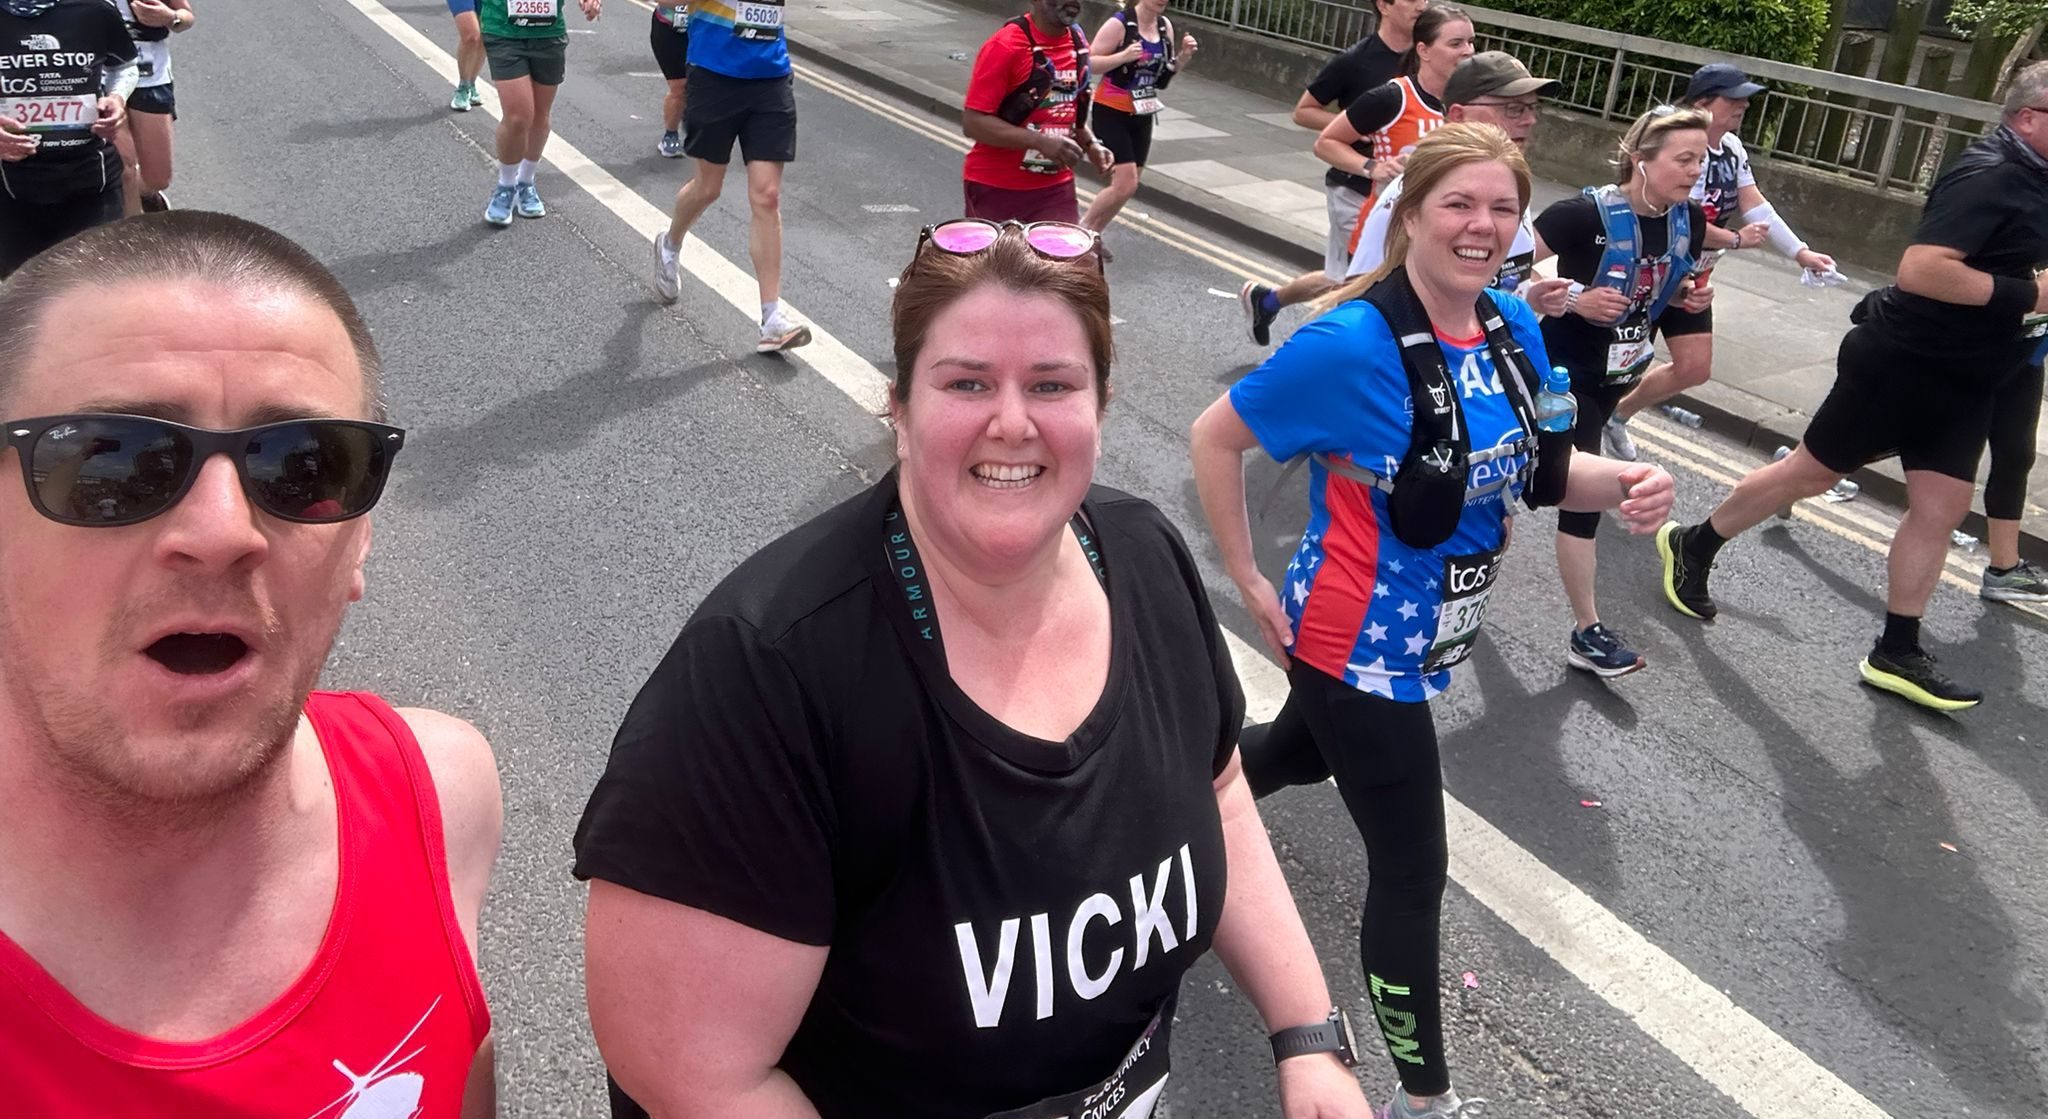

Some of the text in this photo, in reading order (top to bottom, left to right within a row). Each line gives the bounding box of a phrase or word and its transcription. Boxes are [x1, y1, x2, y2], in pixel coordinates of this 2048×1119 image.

[515, 1, 550, 14] 23565
[745, 7, 778, 24] 65030
[52, 52, 95, 66] STOP
[1, 75, 37, 93] tcs
[15, 101, 83, 123] 32477
[61, 138, 91, 146] balanc
[890, 532, 933, 640] ARMOUR
[1450, 564, 1488, 593] tcs
[954, 843, 1198, 1028] VICKI
